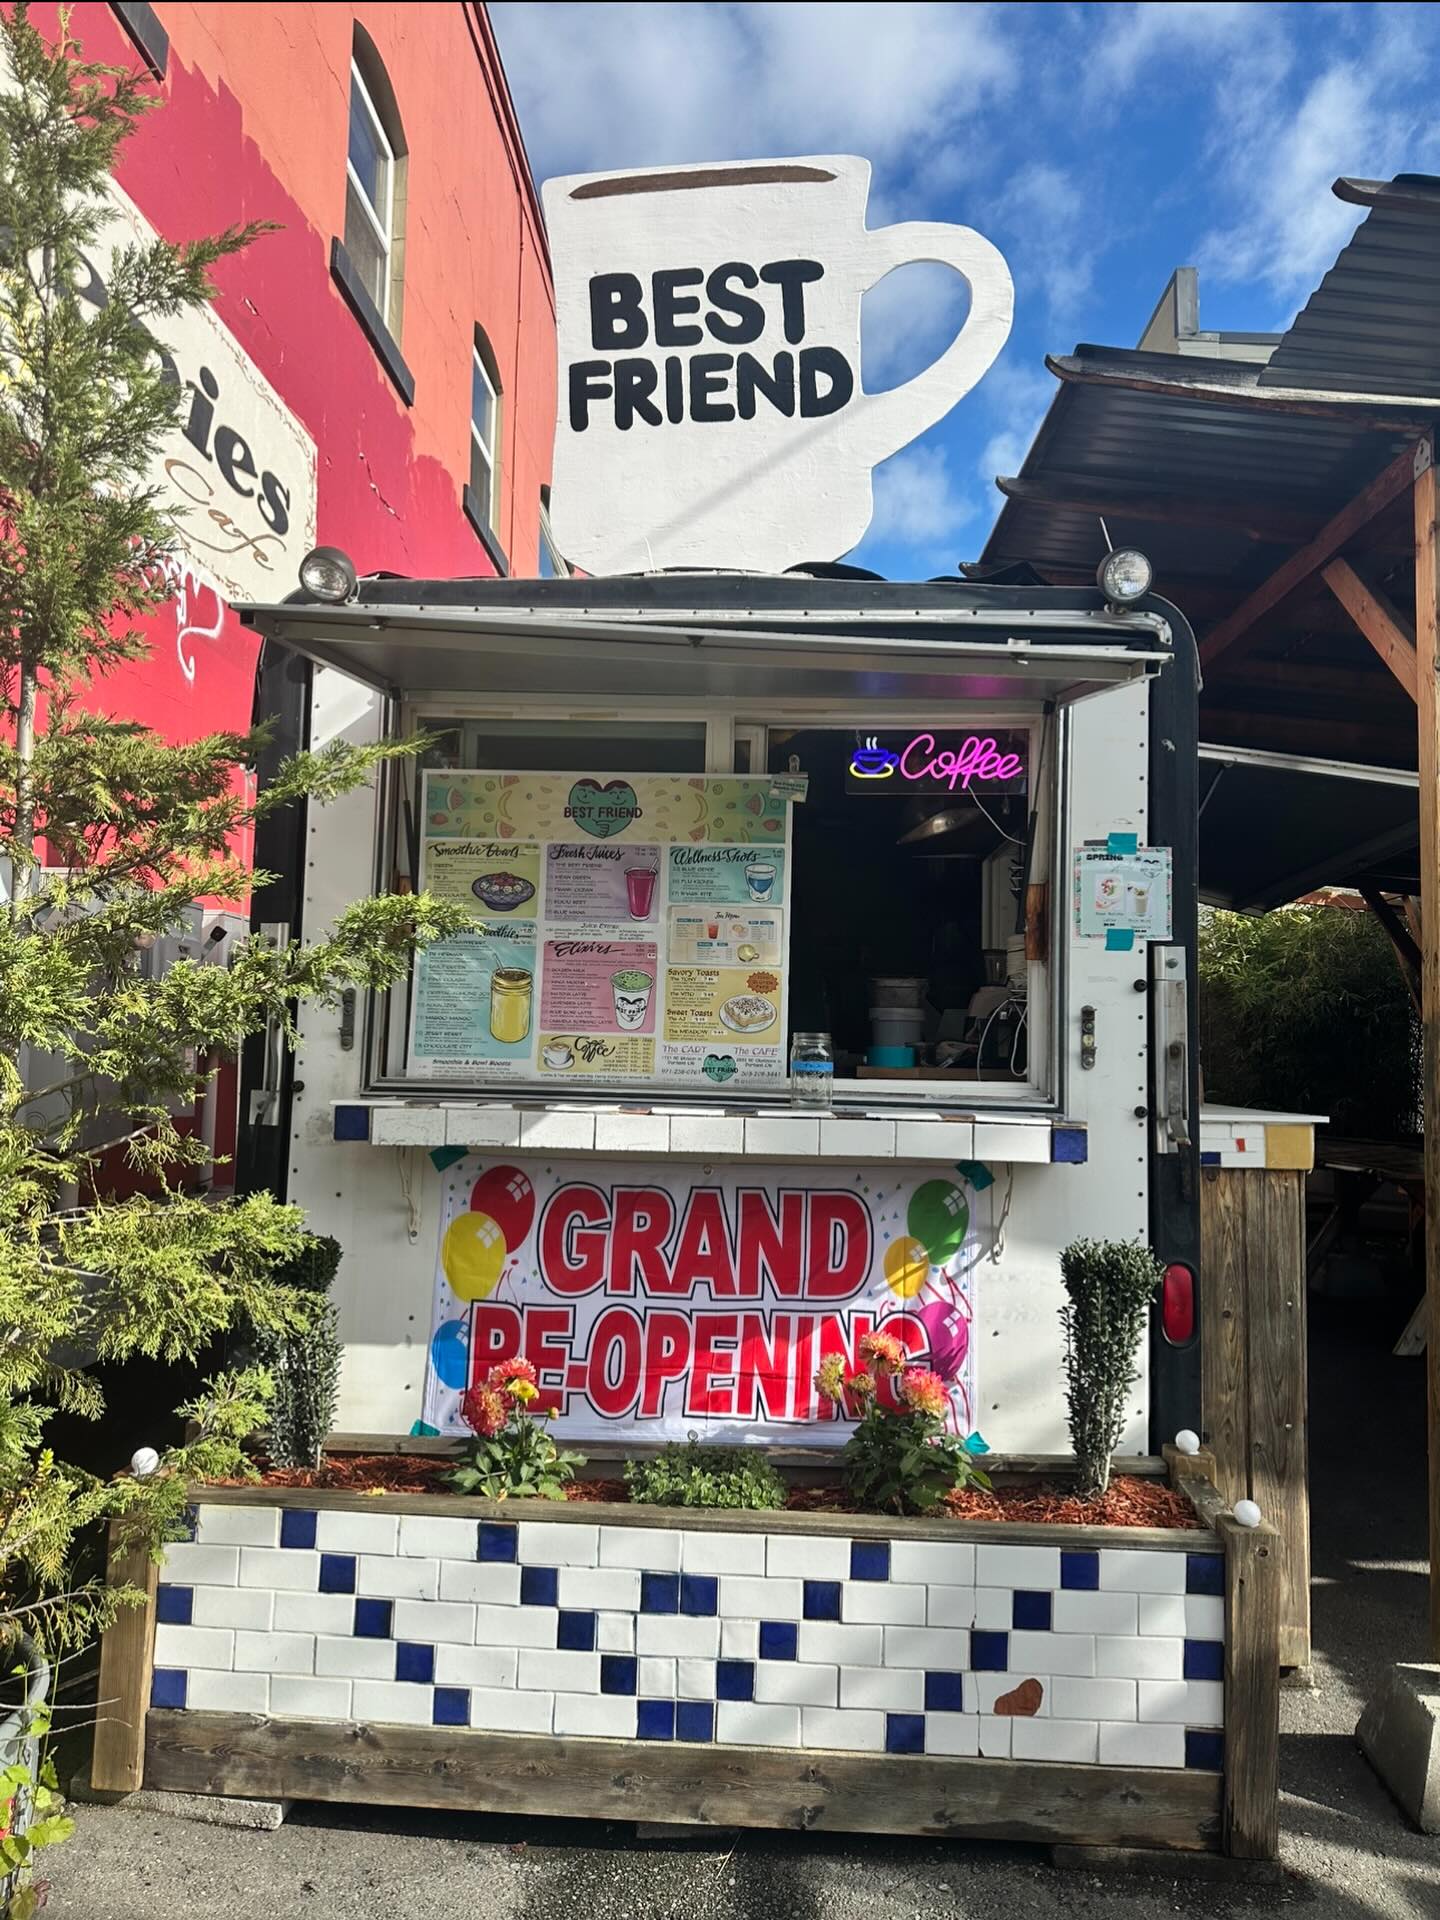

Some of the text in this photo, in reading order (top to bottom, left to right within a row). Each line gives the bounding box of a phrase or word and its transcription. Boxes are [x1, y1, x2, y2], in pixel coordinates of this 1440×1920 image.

[588, 258, 825, 351] BEST
[568, 345, 854, 432] FRIEND
[900, 733, 1024, 790] Coffee
[563, 806, 643, 819] BEST FRIEND
[428, 842, 482, 858] Smoothie
[550, 843, 585, 860] Fresh
[586, 844, 626, 861] Juices
[670, 847, 722, 865] Wellness
[721, 848, 760, 863] Shots
[548, 941, 614, 958] Elixirs
[667, 968, 720, 978] Savory Toasts
[666, 1008, 713, 1017] Sweet Toasts
[662, 1045, 679, 1054] The
[733, 1046, 750, 1056] The
[537, 1181, 874, 1300] GRAND
[466, 1300, 934, 1423] RE-OPENING
